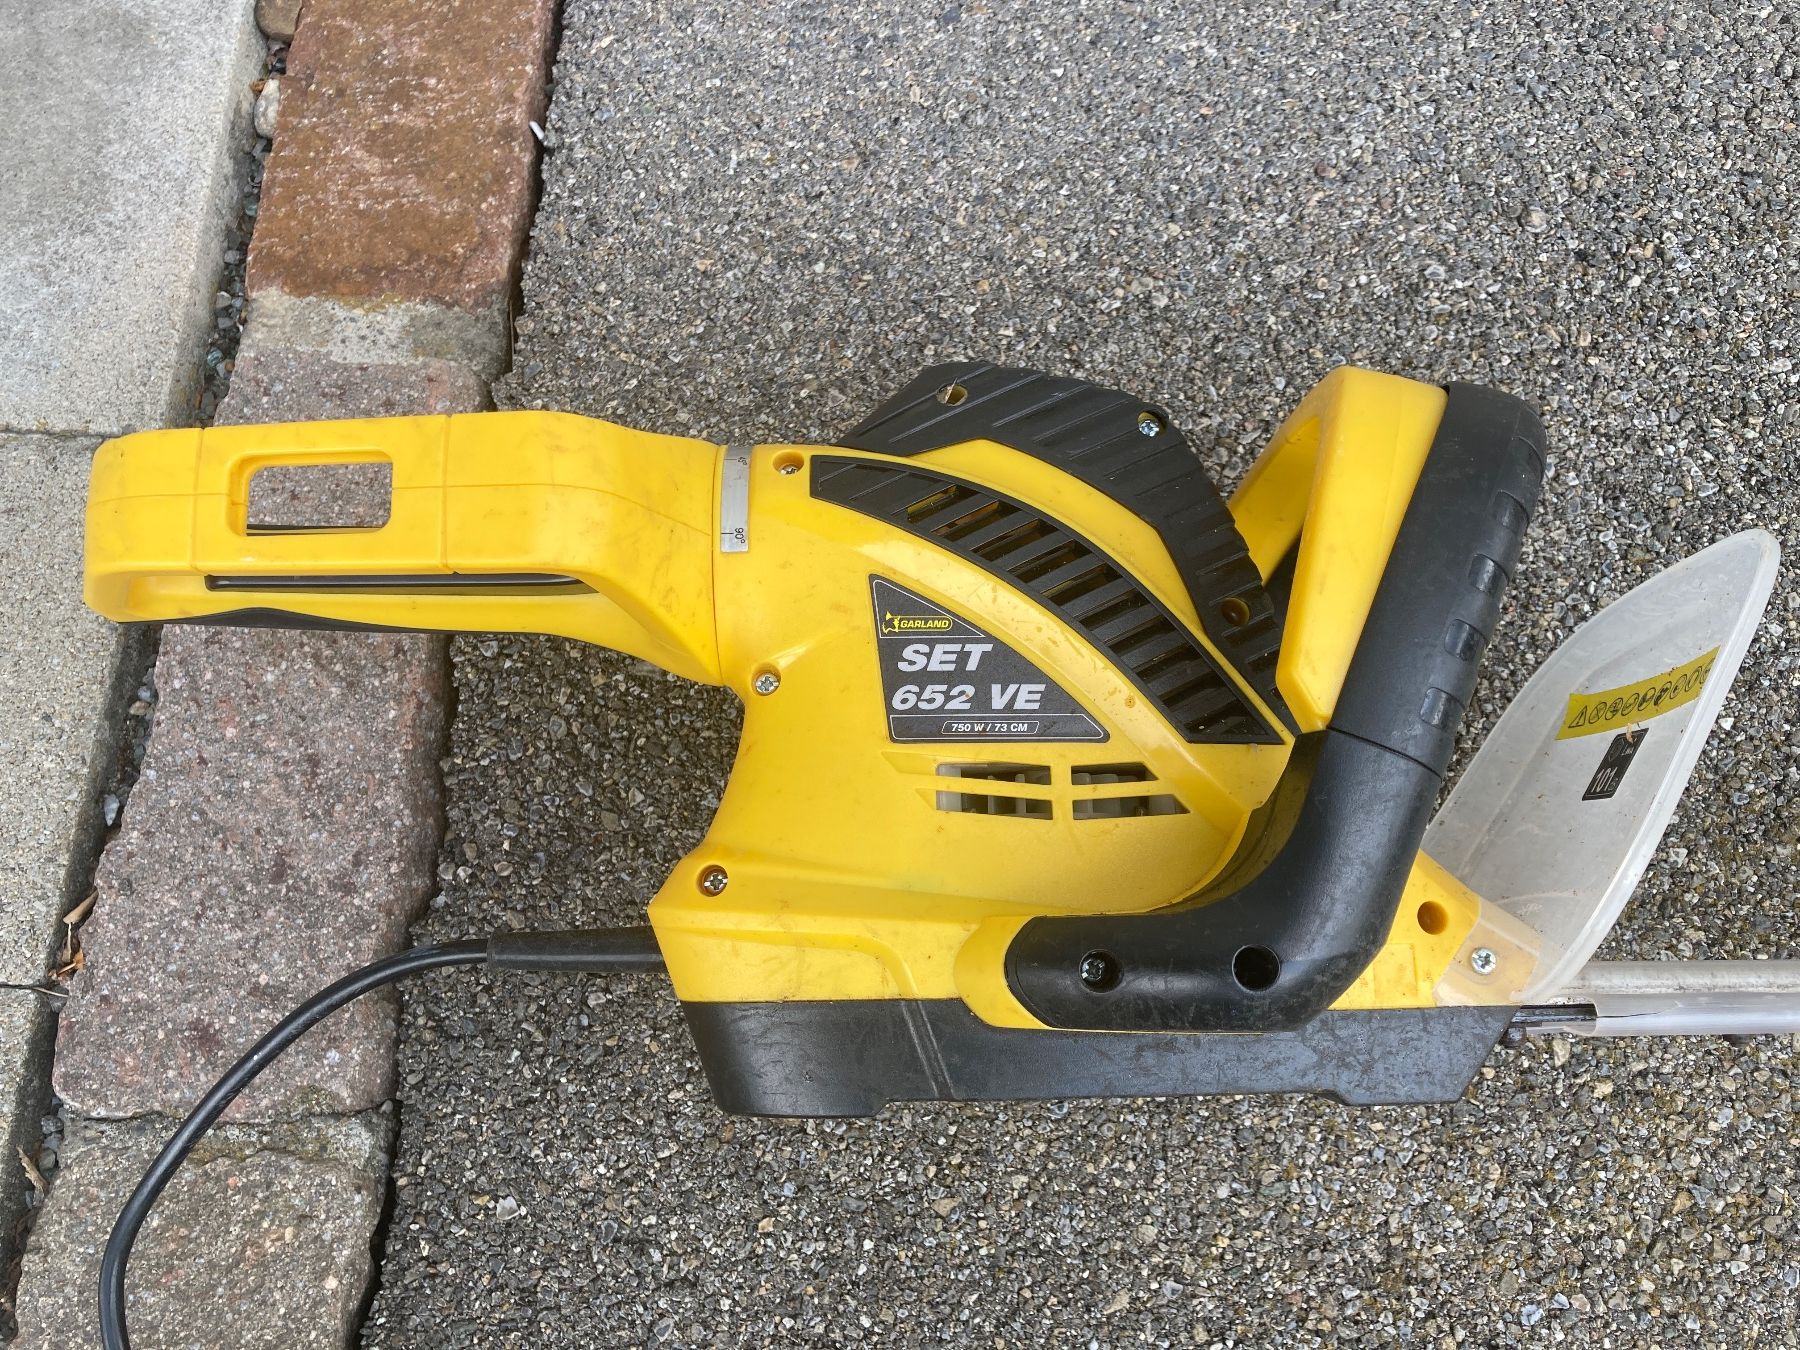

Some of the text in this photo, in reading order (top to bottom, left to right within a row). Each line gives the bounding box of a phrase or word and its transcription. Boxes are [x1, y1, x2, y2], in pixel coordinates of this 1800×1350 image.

[900, 619, 949, 629] GARLAND
[897, 643, 993, 672] SET
[891, 683, 1046, 711] 652 VE
[951, 723, 971, 732] 750
[974, 723, 985, 732] W
[994, 723, 1008, 732] 73
[1010, 723, 1028, 732] CM
[1591, 767, 1618, 793] 101
